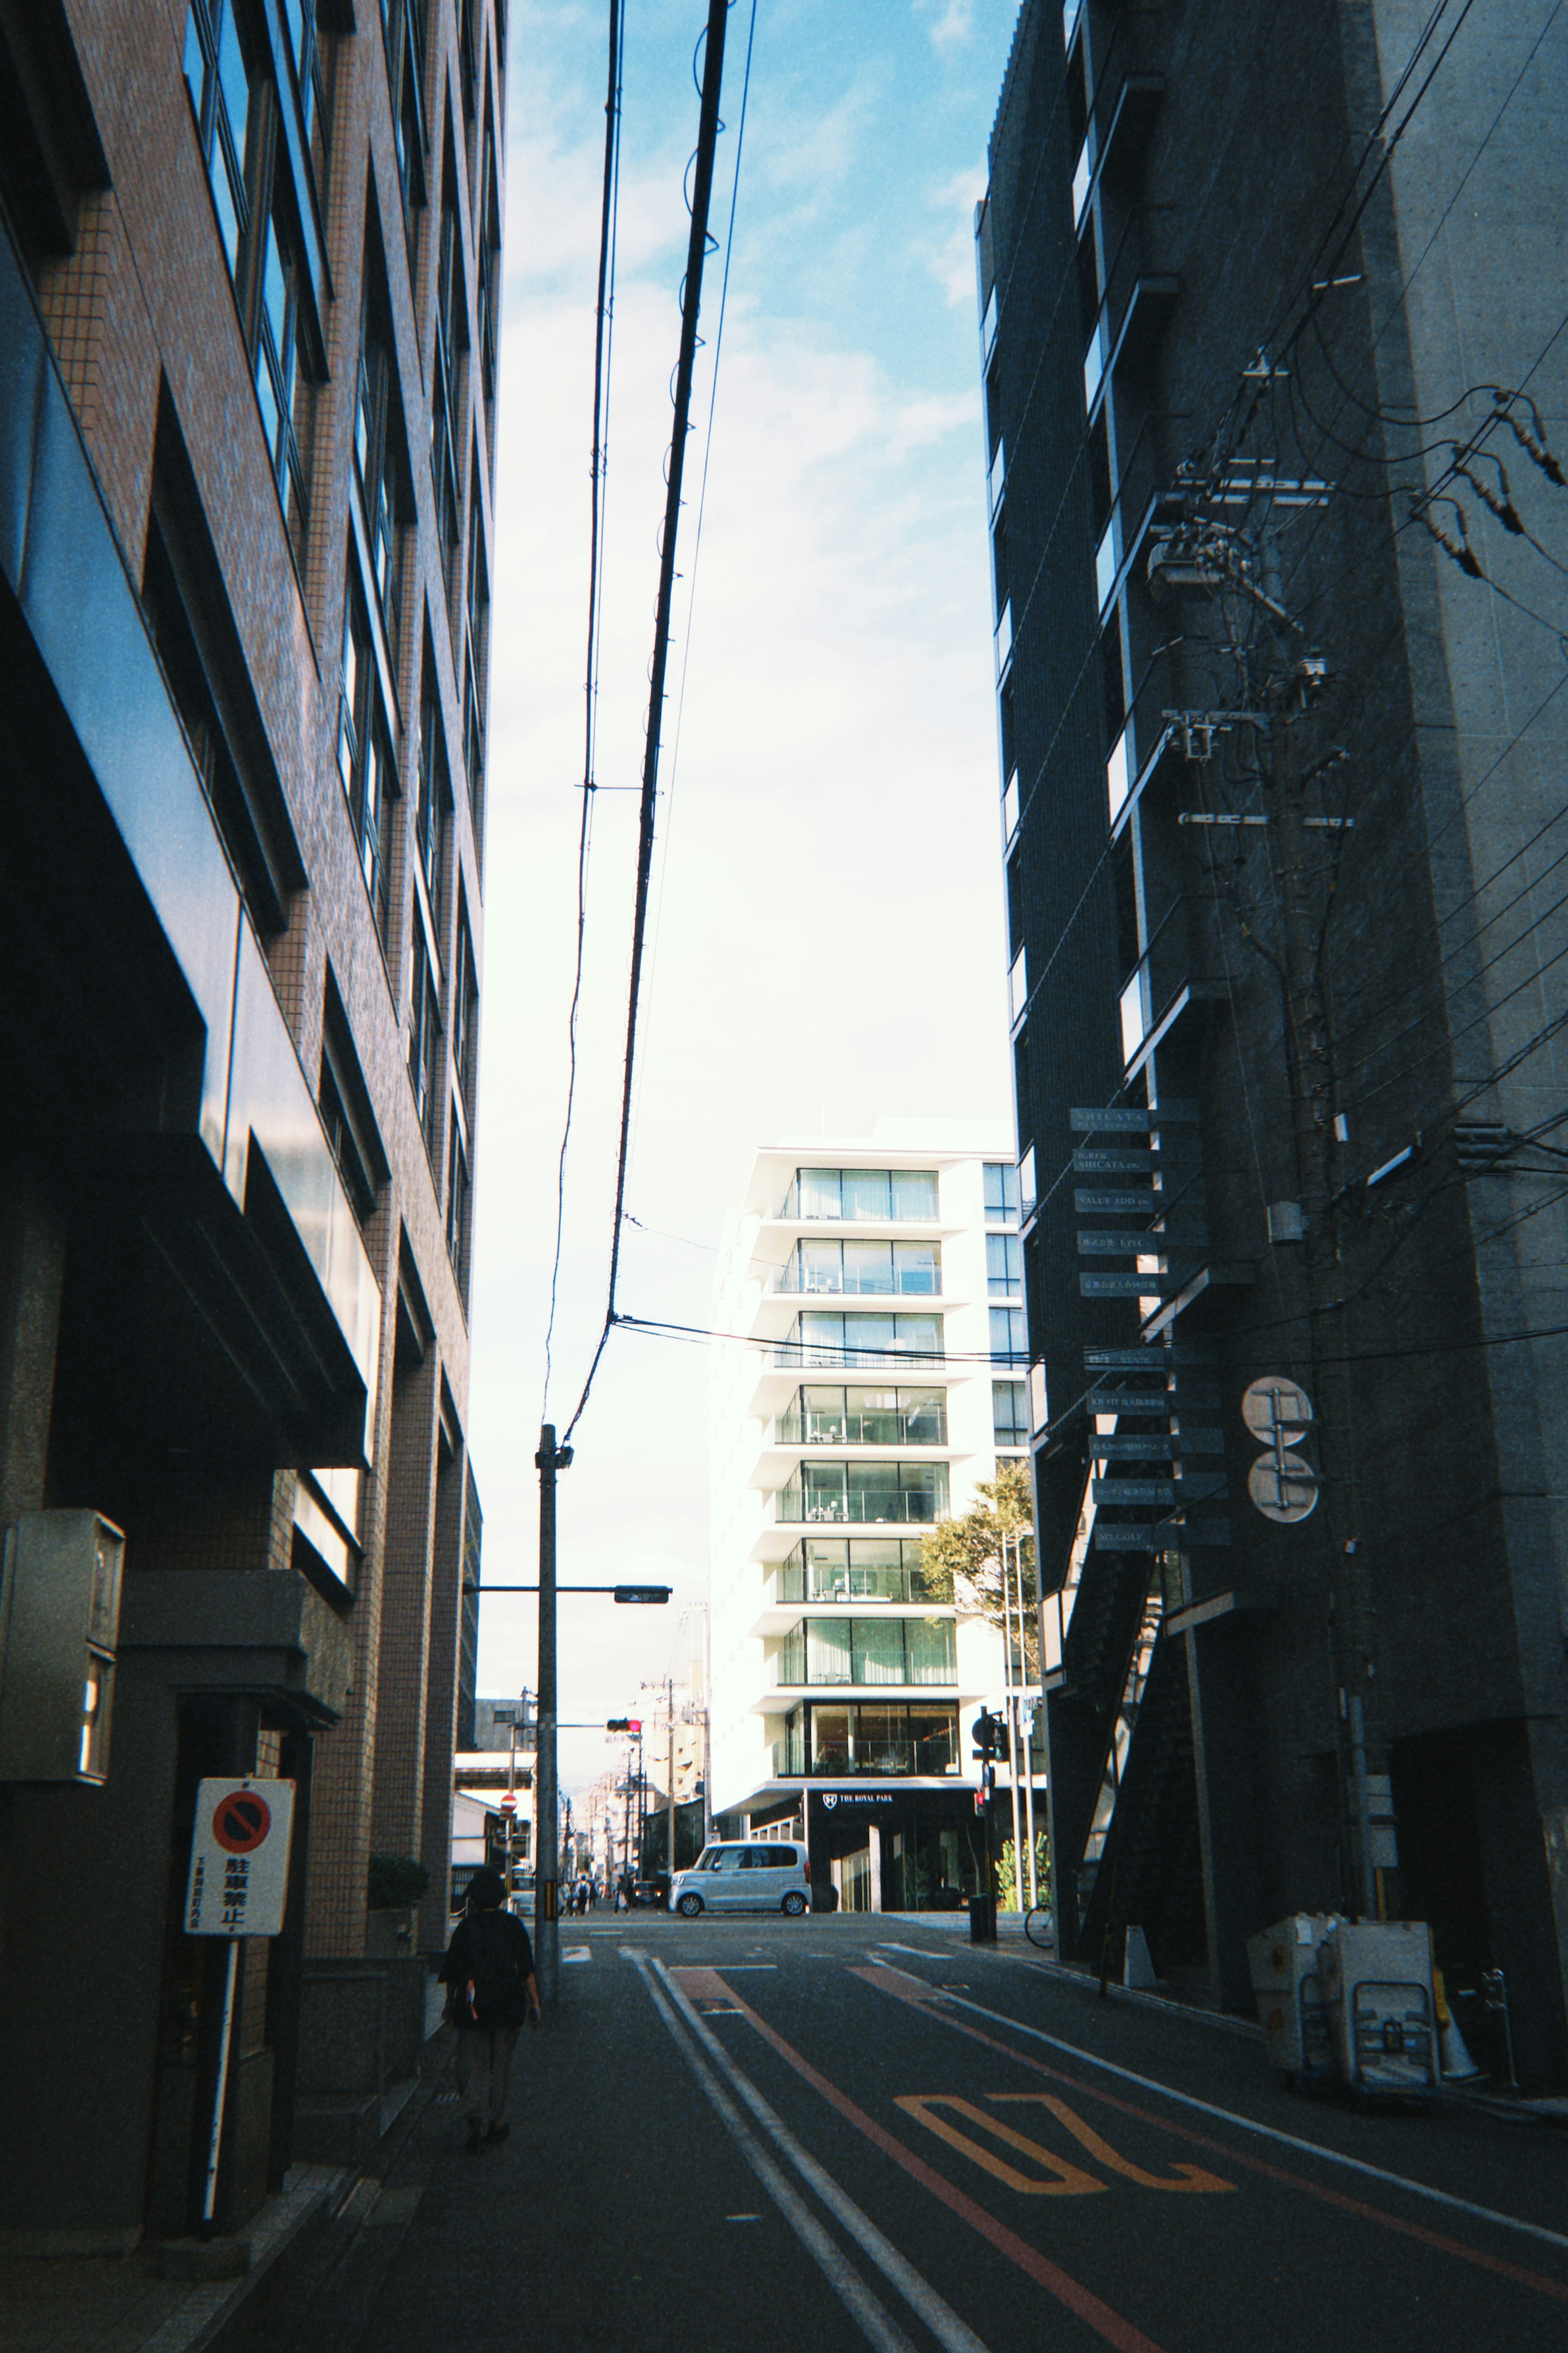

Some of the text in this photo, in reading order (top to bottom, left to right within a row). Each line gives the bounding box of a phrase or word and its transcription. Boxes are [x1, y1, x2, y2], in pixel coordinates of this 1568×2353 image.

[1077, 1112, 1143, 1121] SHICATA
[840, 1794, 893, 1803] THE ROYAL PARK
[220, 1858, 251, 1924] 駐車禁止
